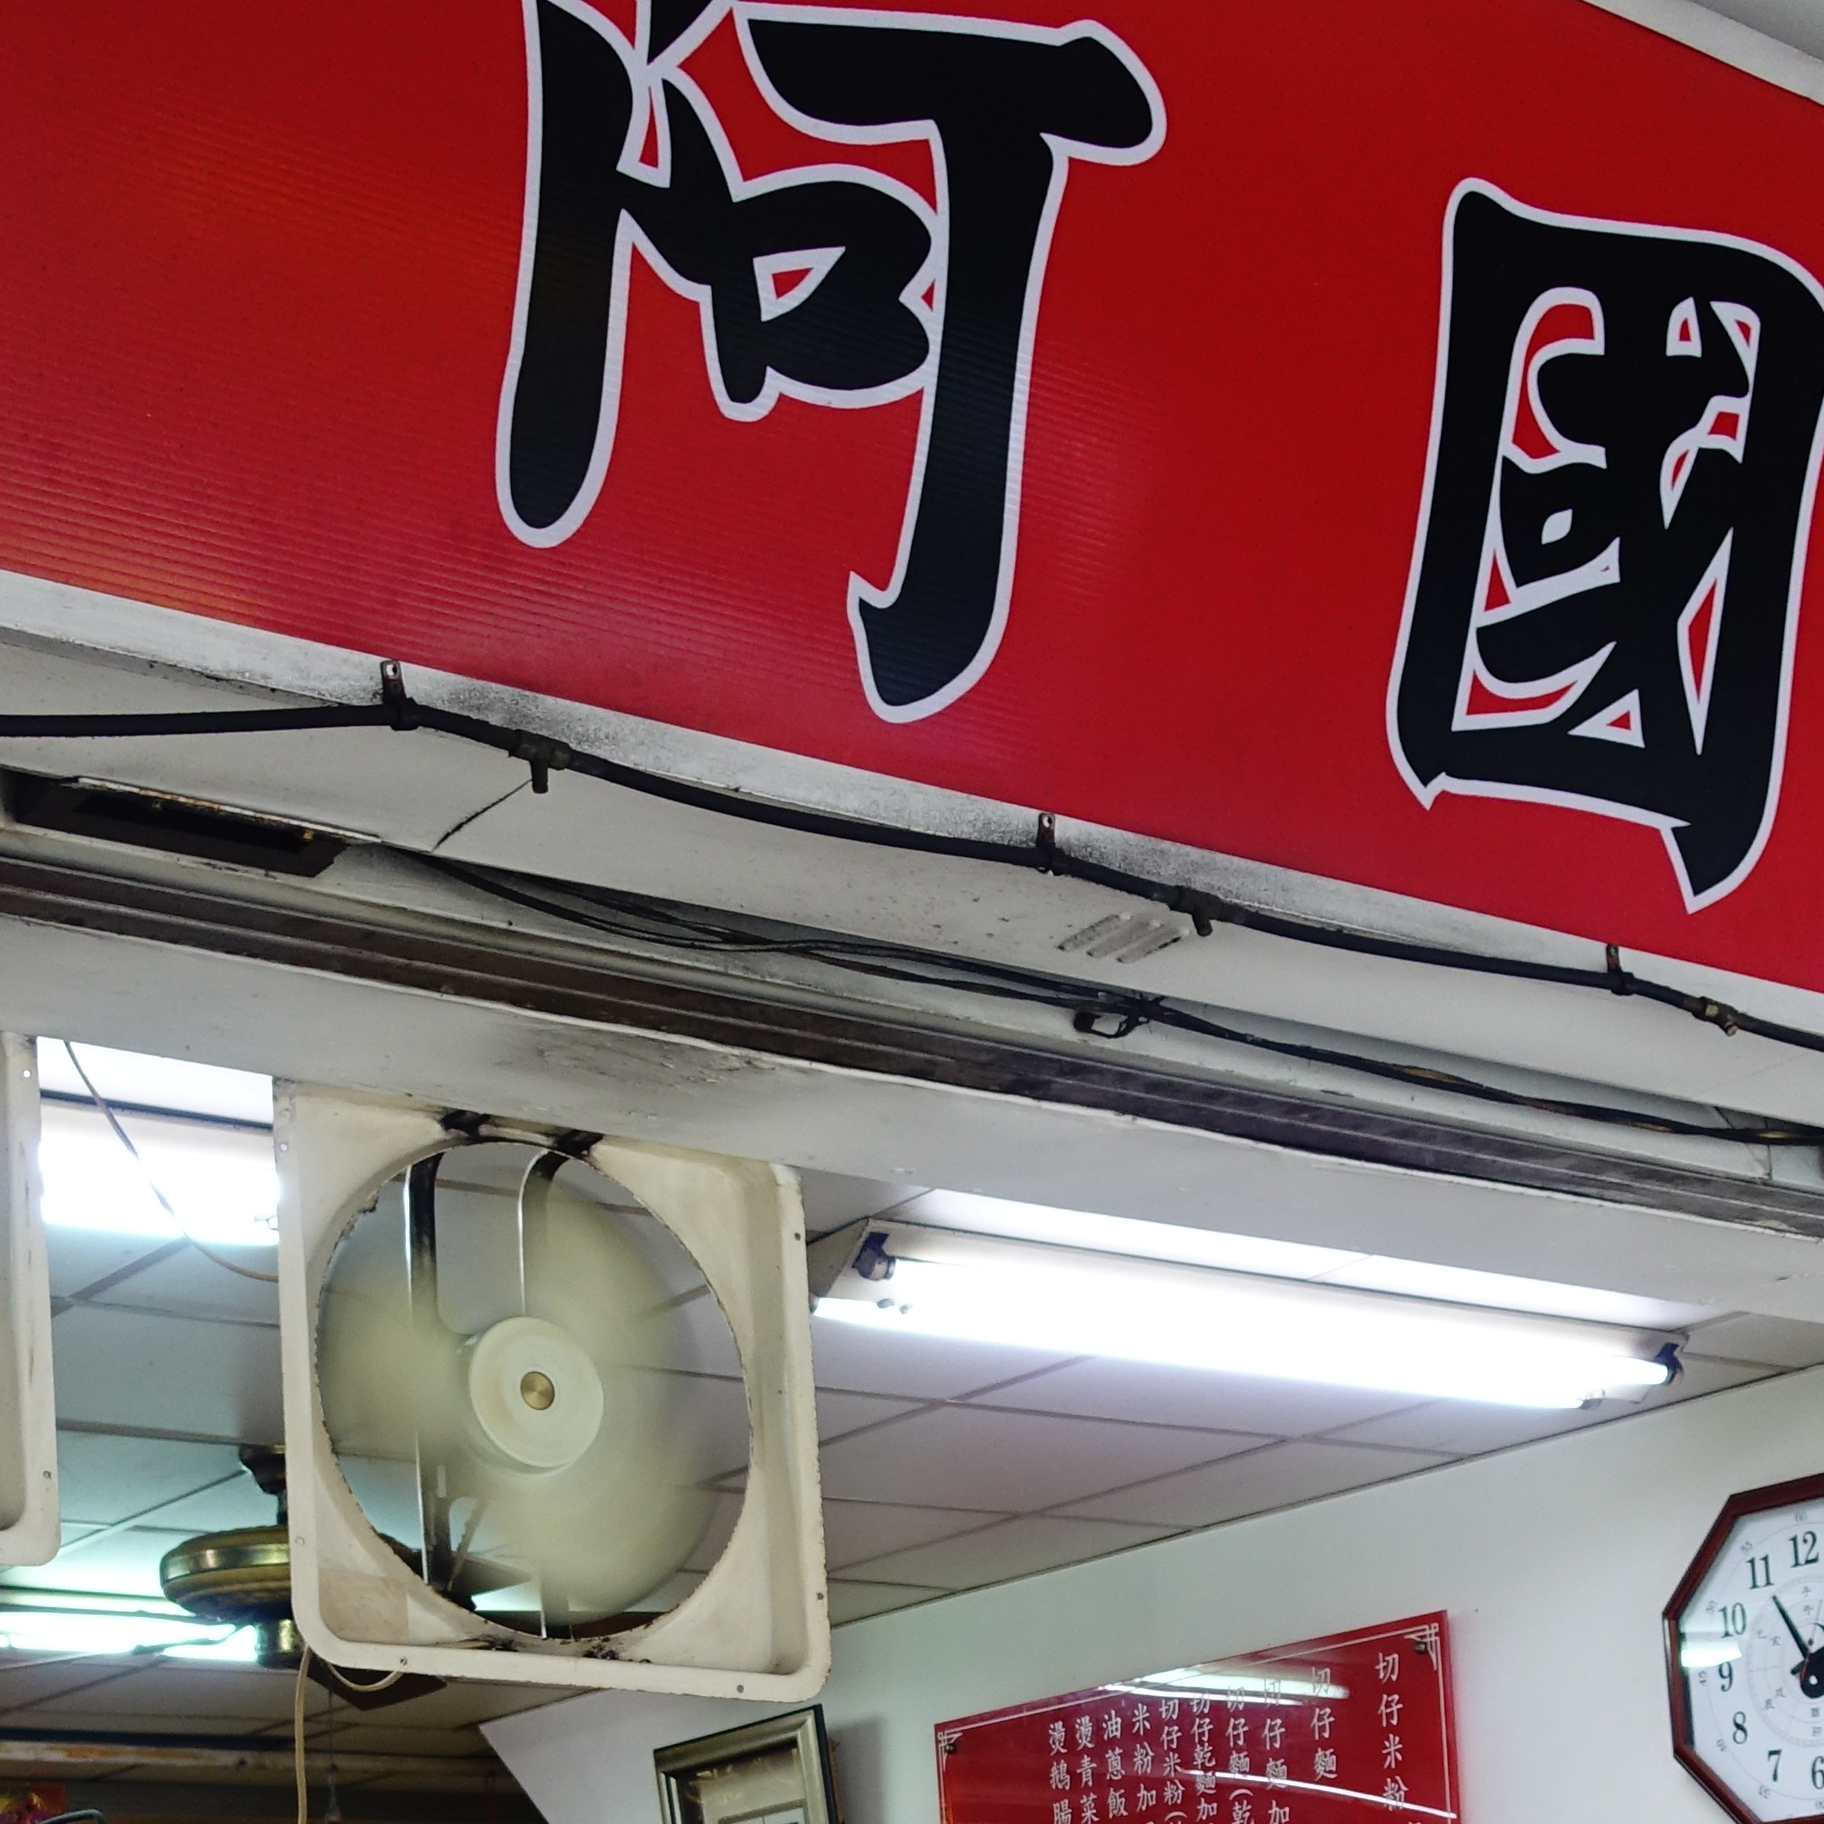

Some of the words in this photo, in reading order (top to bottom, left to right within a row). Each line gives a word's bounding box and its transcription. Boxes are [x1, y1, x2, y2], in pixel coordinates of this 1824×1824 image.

[1788, 1530, 1821, 1569] 12
[1746, 1554, 1774, 1590] 11
[1719, 1602, 1747, 1638] 10
[1719, 1662, 1734, 1692] 9
[1311, 1667, 1338, 1781] 切仔麵
[1376, 1652, 1409, 1811] 切仔米粉
[1733, 1711, 1748, 1744] 8
[1768, 1749, 1782, 1782] 7
